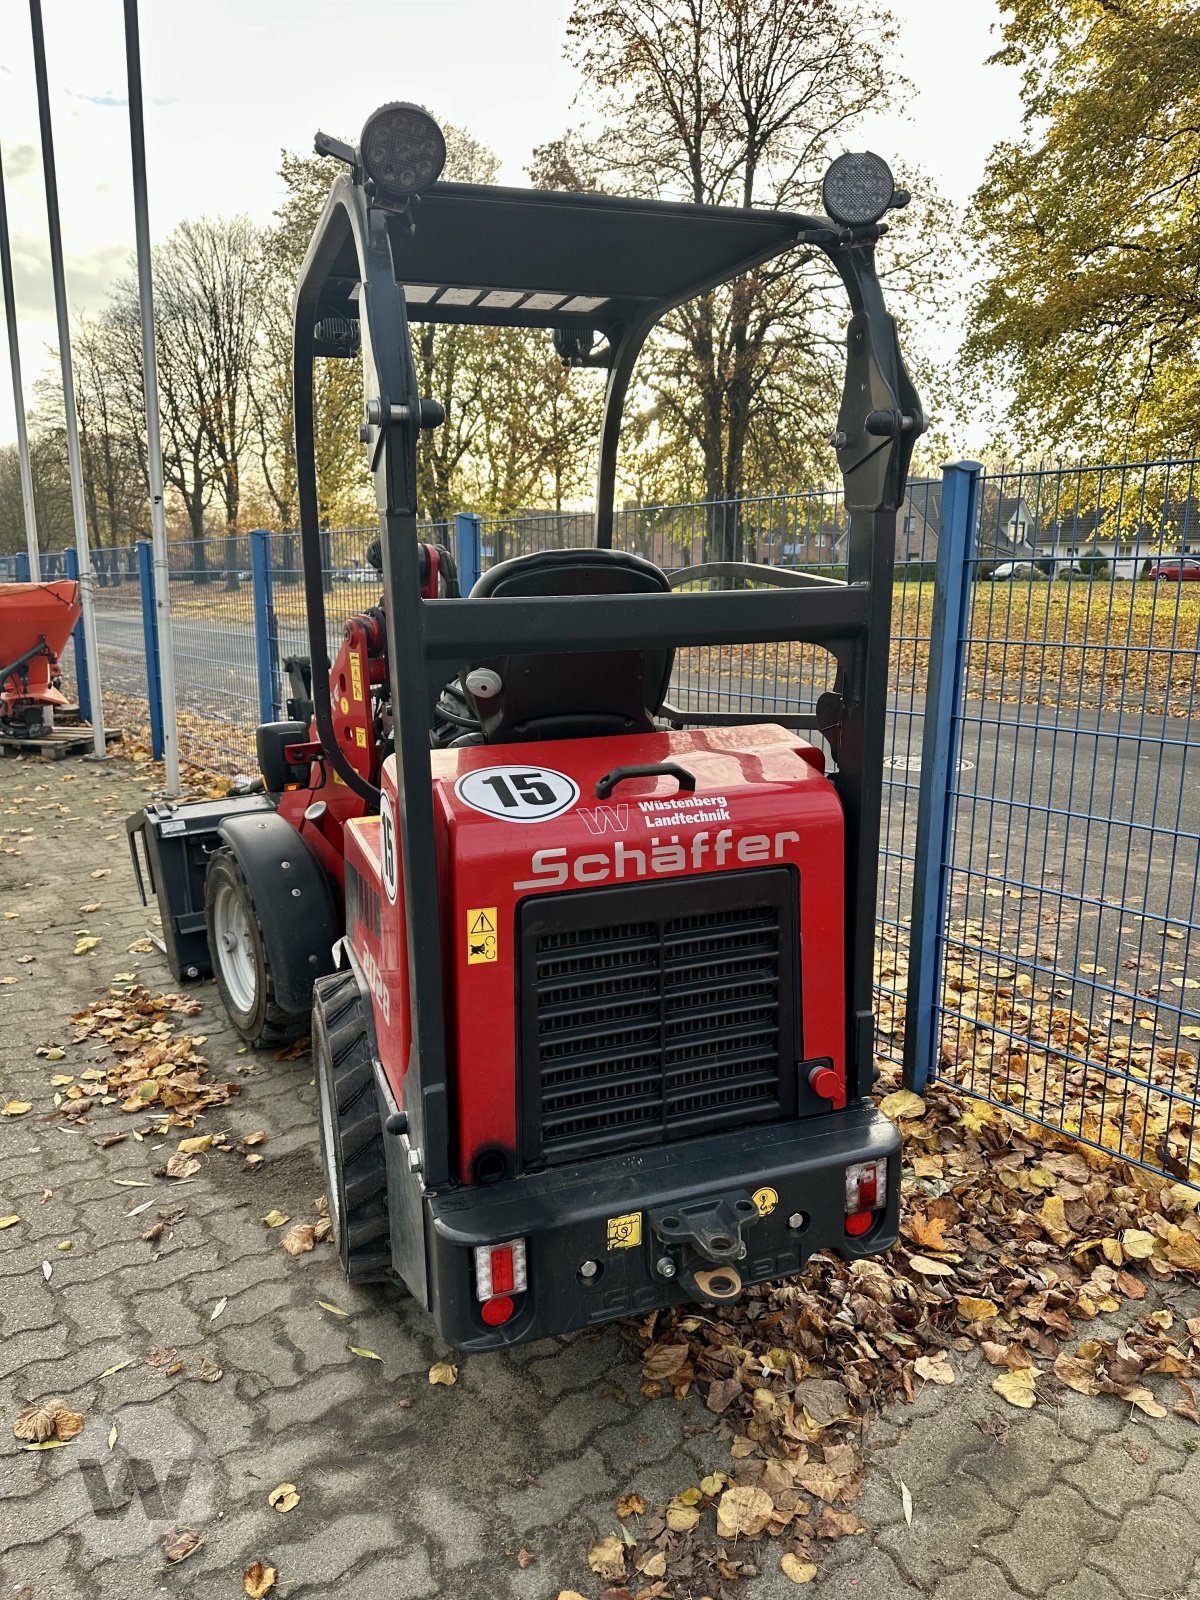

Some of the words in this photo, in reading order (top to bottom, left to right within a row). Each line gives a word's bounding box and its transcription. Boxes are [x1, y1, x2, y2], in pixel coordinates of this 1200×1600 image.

[481, 772, 558, 808] 15
[637, 794, 729, 812] Wüstenberg
[644, 808, 732, 829] Landtechnik
[380, 810, 396, 888] 15
[512, 828, 801, 891] Schäffer
